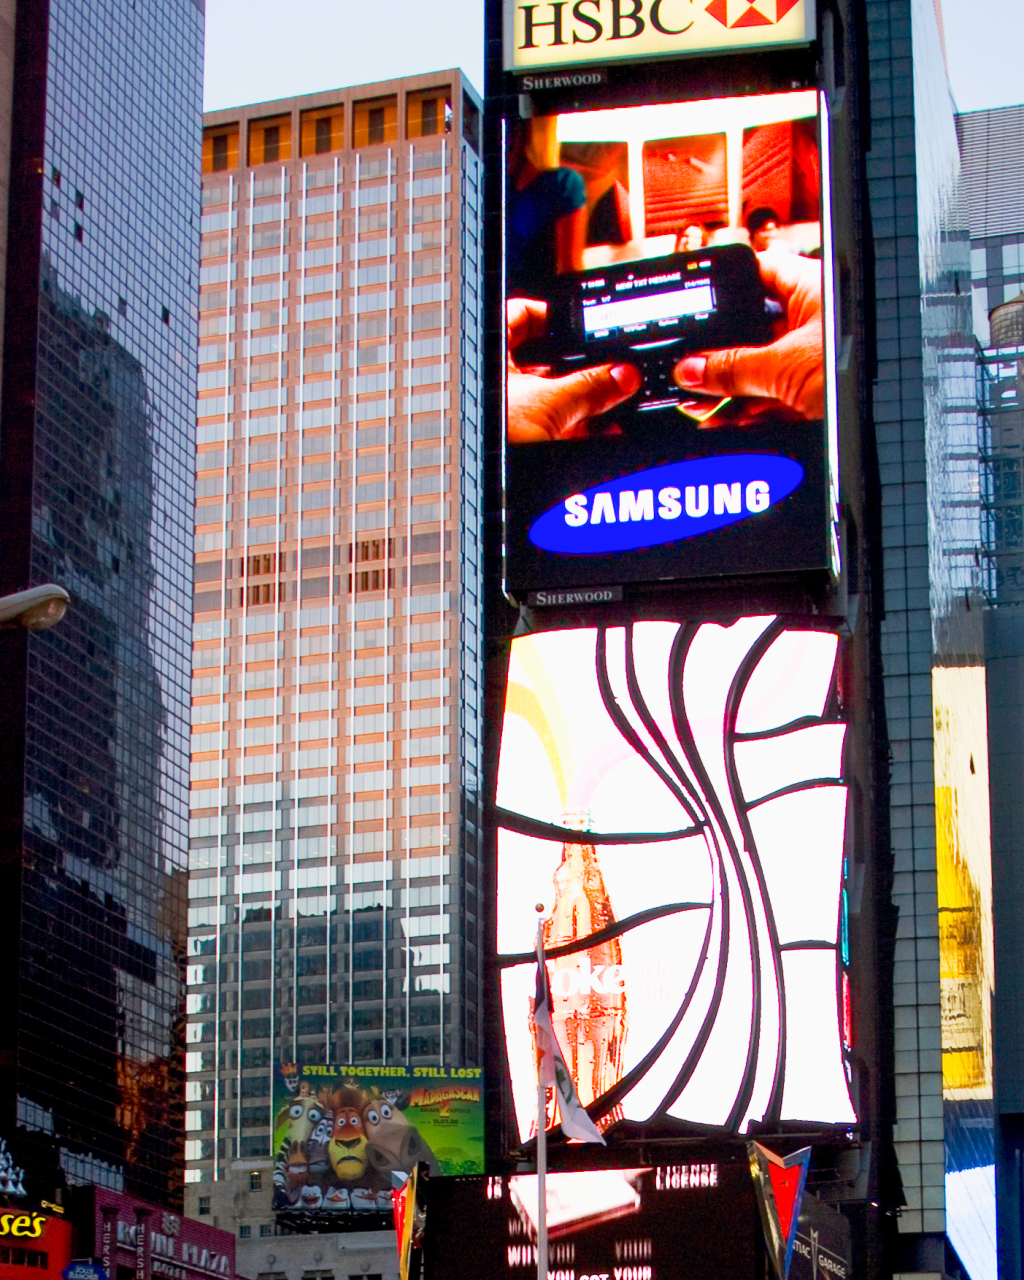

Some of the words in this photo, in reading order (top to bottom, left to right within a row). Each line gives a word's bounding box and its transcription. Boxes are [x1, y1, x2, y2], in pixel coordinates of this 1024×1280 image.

[517, 0, 695, 51] HSBC
[522, 72, 602, 91] SHERWOOD
[564, 480, 771, 527] SAMSUNG
[536, 589, 613, 606] SHERWOOD
[302, 1065, 338, 1077] STILL
[339, 1066, 410, 1078] TOGETHER,
[413, 1067, 448, 1078] STILL
[450, 1067, 482, 1078] LOST
[410, 1087, 480, 1107] MADAGASCAR
[439, 1100, 451, 1118] 2
[655, 1163, 719, 1191] LICENSE
[68, 1271, 99, 1280] RANCHER
[818, 1254, 847, 1280] GARAGE
